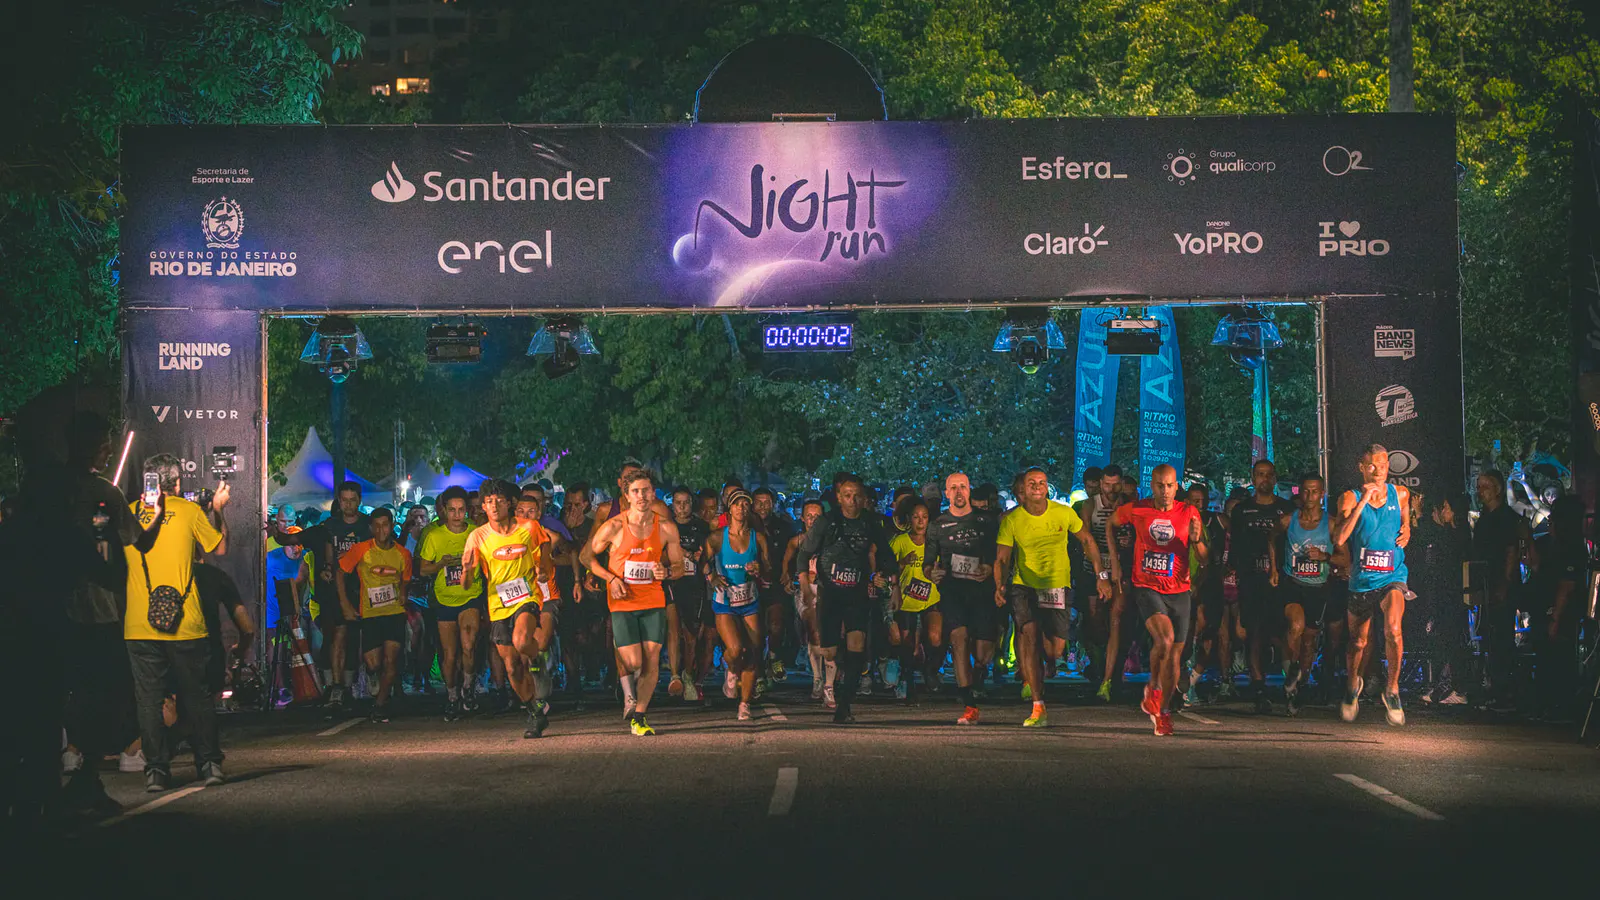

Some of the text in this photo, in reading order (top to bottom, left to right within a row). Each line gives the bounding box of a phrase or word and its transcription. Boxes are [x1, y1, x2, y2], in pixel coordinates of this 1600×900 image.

[1209, 150, 1236, 158] Grupo
[196, 167, 249, 175] Secretaria de
[1209, 159, 1276, 174] qualicorp
[192, 176, 224, 184] Esporte
[423, 170, 611, 201] Santander
[1319, 221, 1335, 238] I
[820, 231, 886, 262] run
[1024, 230, 1098, 255] Claro
[1173, 231, 1263, 254] YoPRO
[1319, 239, 1390, 257] PRIO
[150, 251, 297, 260] GOVERNO DO ESTADO
[438, 230, 552, 274] enel
[150, 261, 297, 277] RIO DE JANEIRO
[766, 326, 850, 347] 00:00:02
[1376, 331, 1412, 340] BAND
[159, 342, 231, 357] RUNNING
[1376, 340, 1413, 348] NEWS
[159, 356, 203, 370] LAND
[184, 409, 239, 419] VETOR
[1143, 411, 1176, 423] RITMO
[1077, 432, 1103, 444] RITMO
[181, 458, 197, 471] io
[1389, 477, 1420, 487] AND
[959, 562, 972, 572] 352
[1145, 556, 1168, 570] 14356
[1297, 562, 1318, 573] 14995
[375, 591, 391, 602] 6286
[504, 584, 523, 599] 6291
